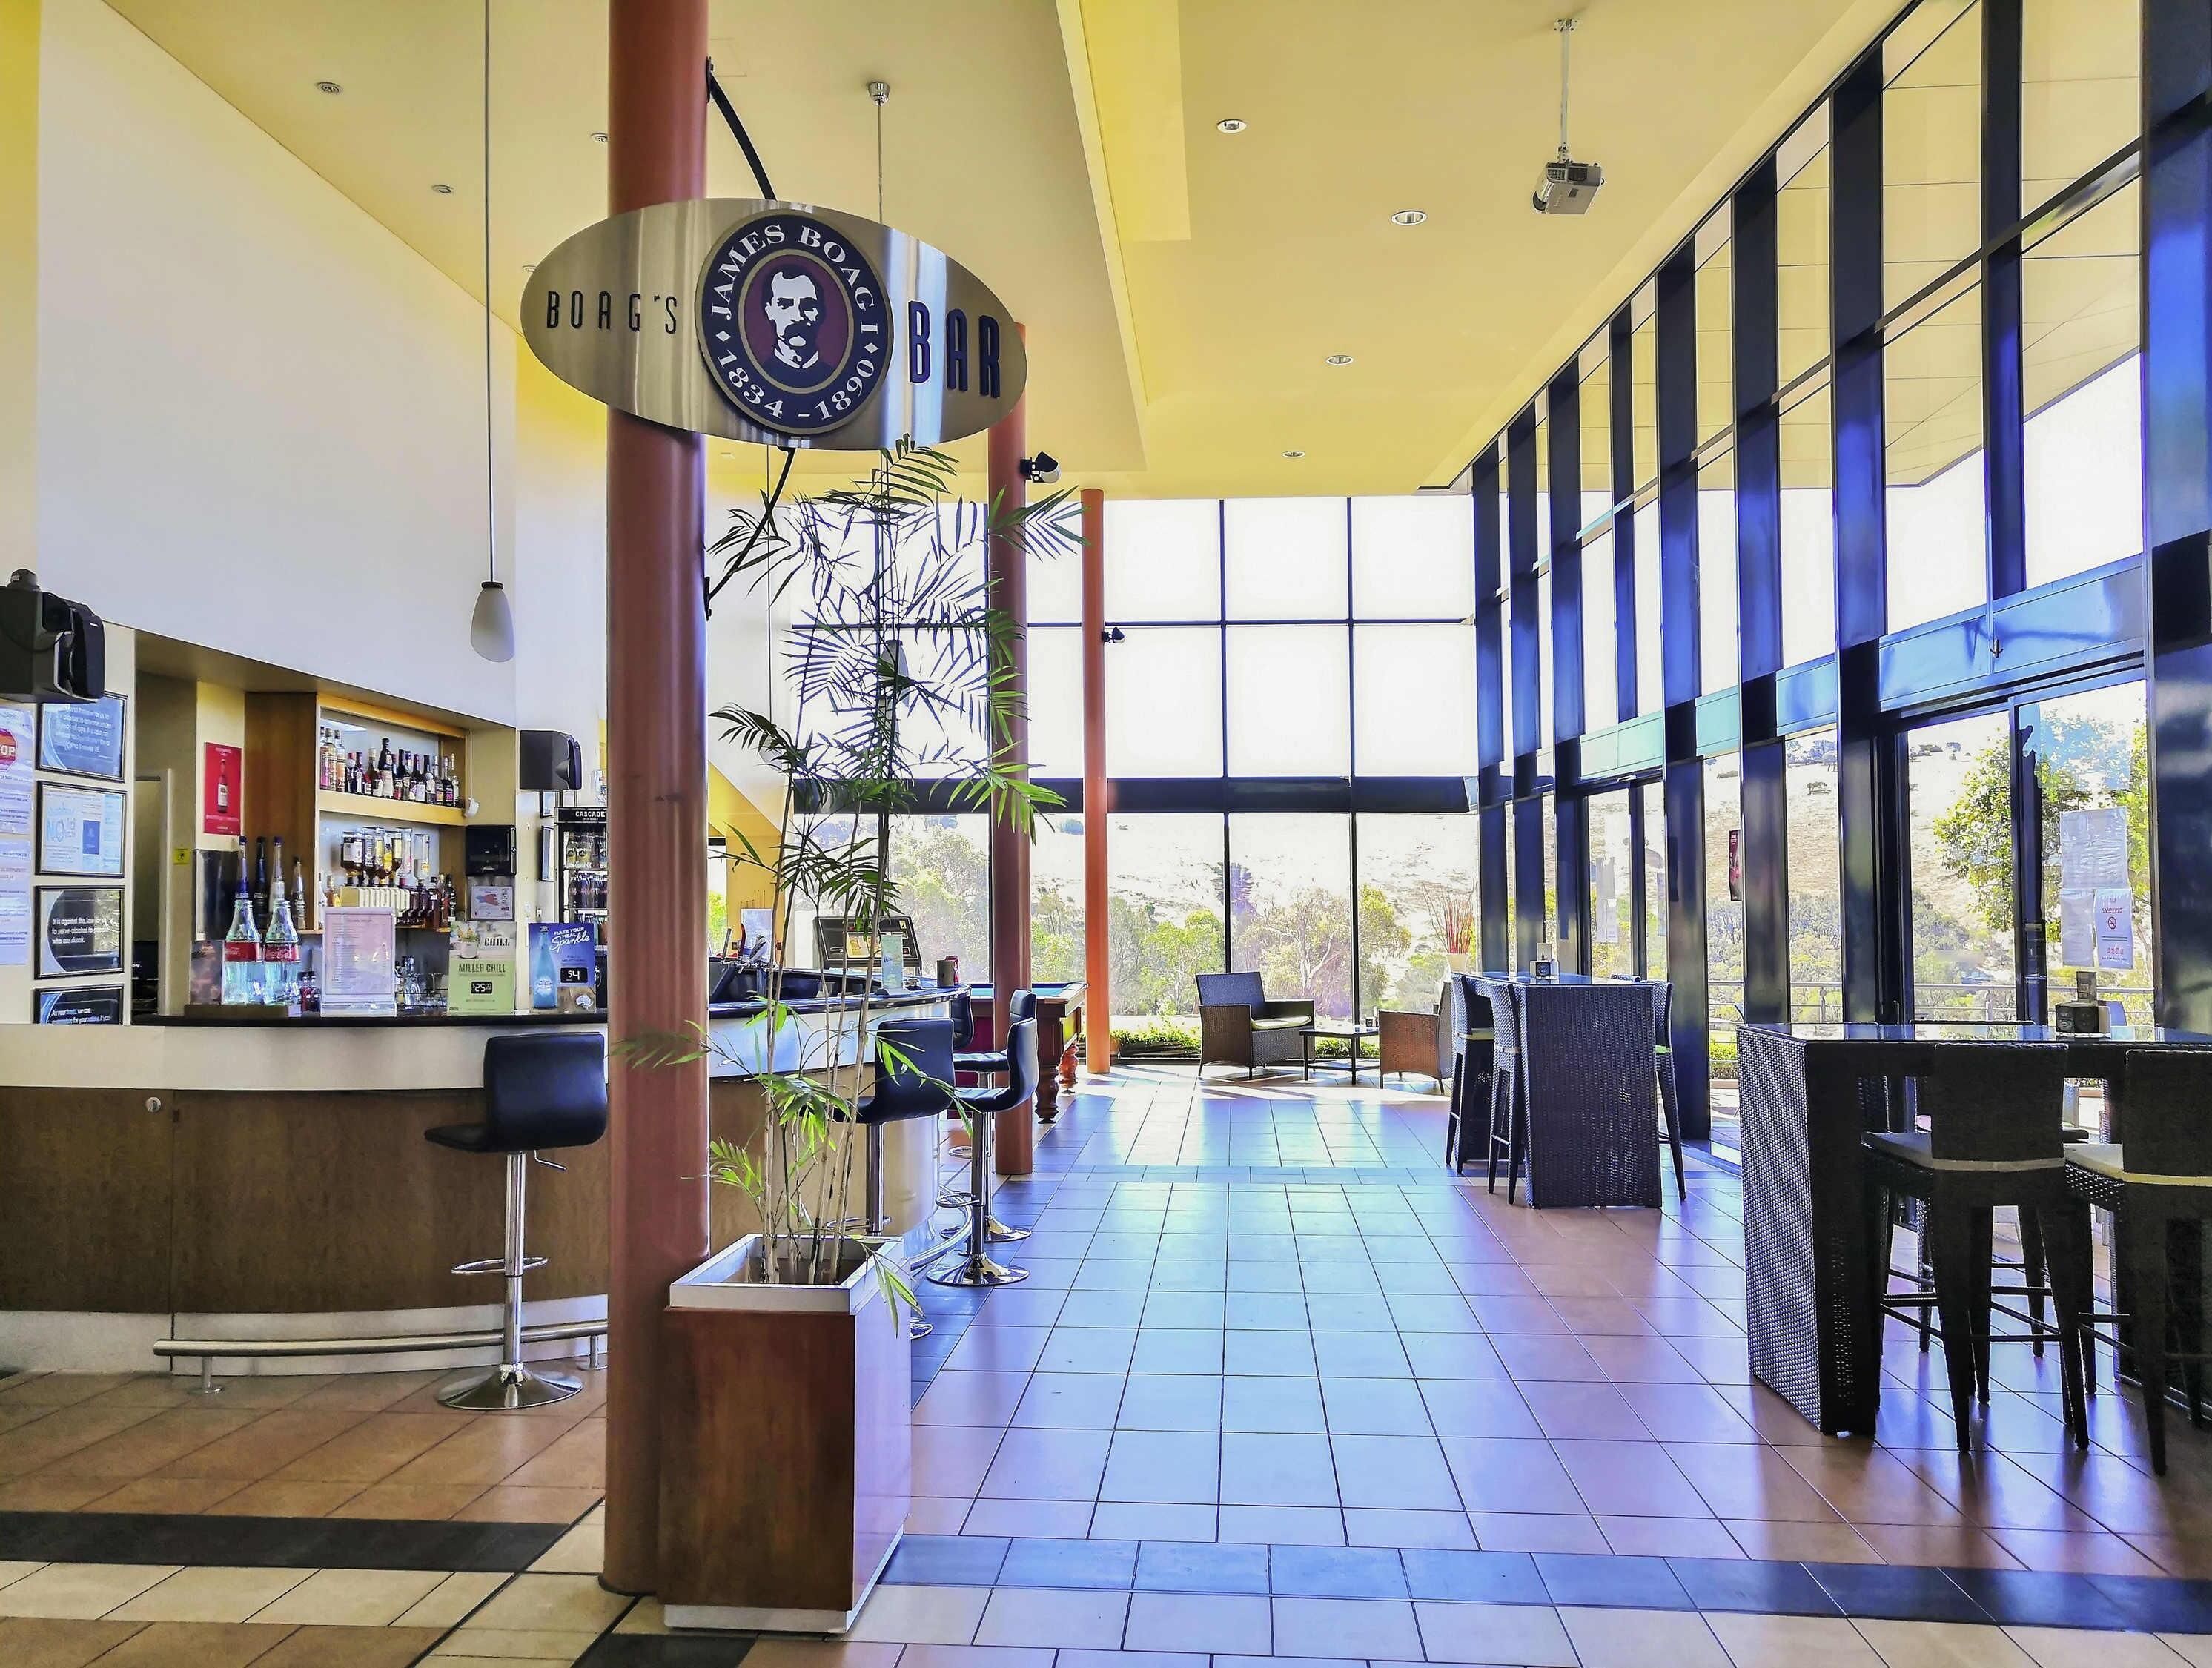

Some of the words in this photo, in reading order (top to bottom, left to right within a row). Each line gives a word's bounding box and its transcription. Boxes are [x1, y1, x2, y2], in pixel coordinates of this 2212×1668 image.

[711, 224, 786, 322] JAMES
[798, 225, 875, 311] BOAG
[546, 290, 678, 335] BOAG'S
[907, 299, 1001, 399] BAR
[717, 348, 784, 420] 1834
[814, 359, 875, 420] 1890
[484, 938, 510, 946] CHILL
[551, 930, 591, 952] Sparkle
[459, 963, 484, 973] MILLER
[486, 963, 506, 973] CHILL
